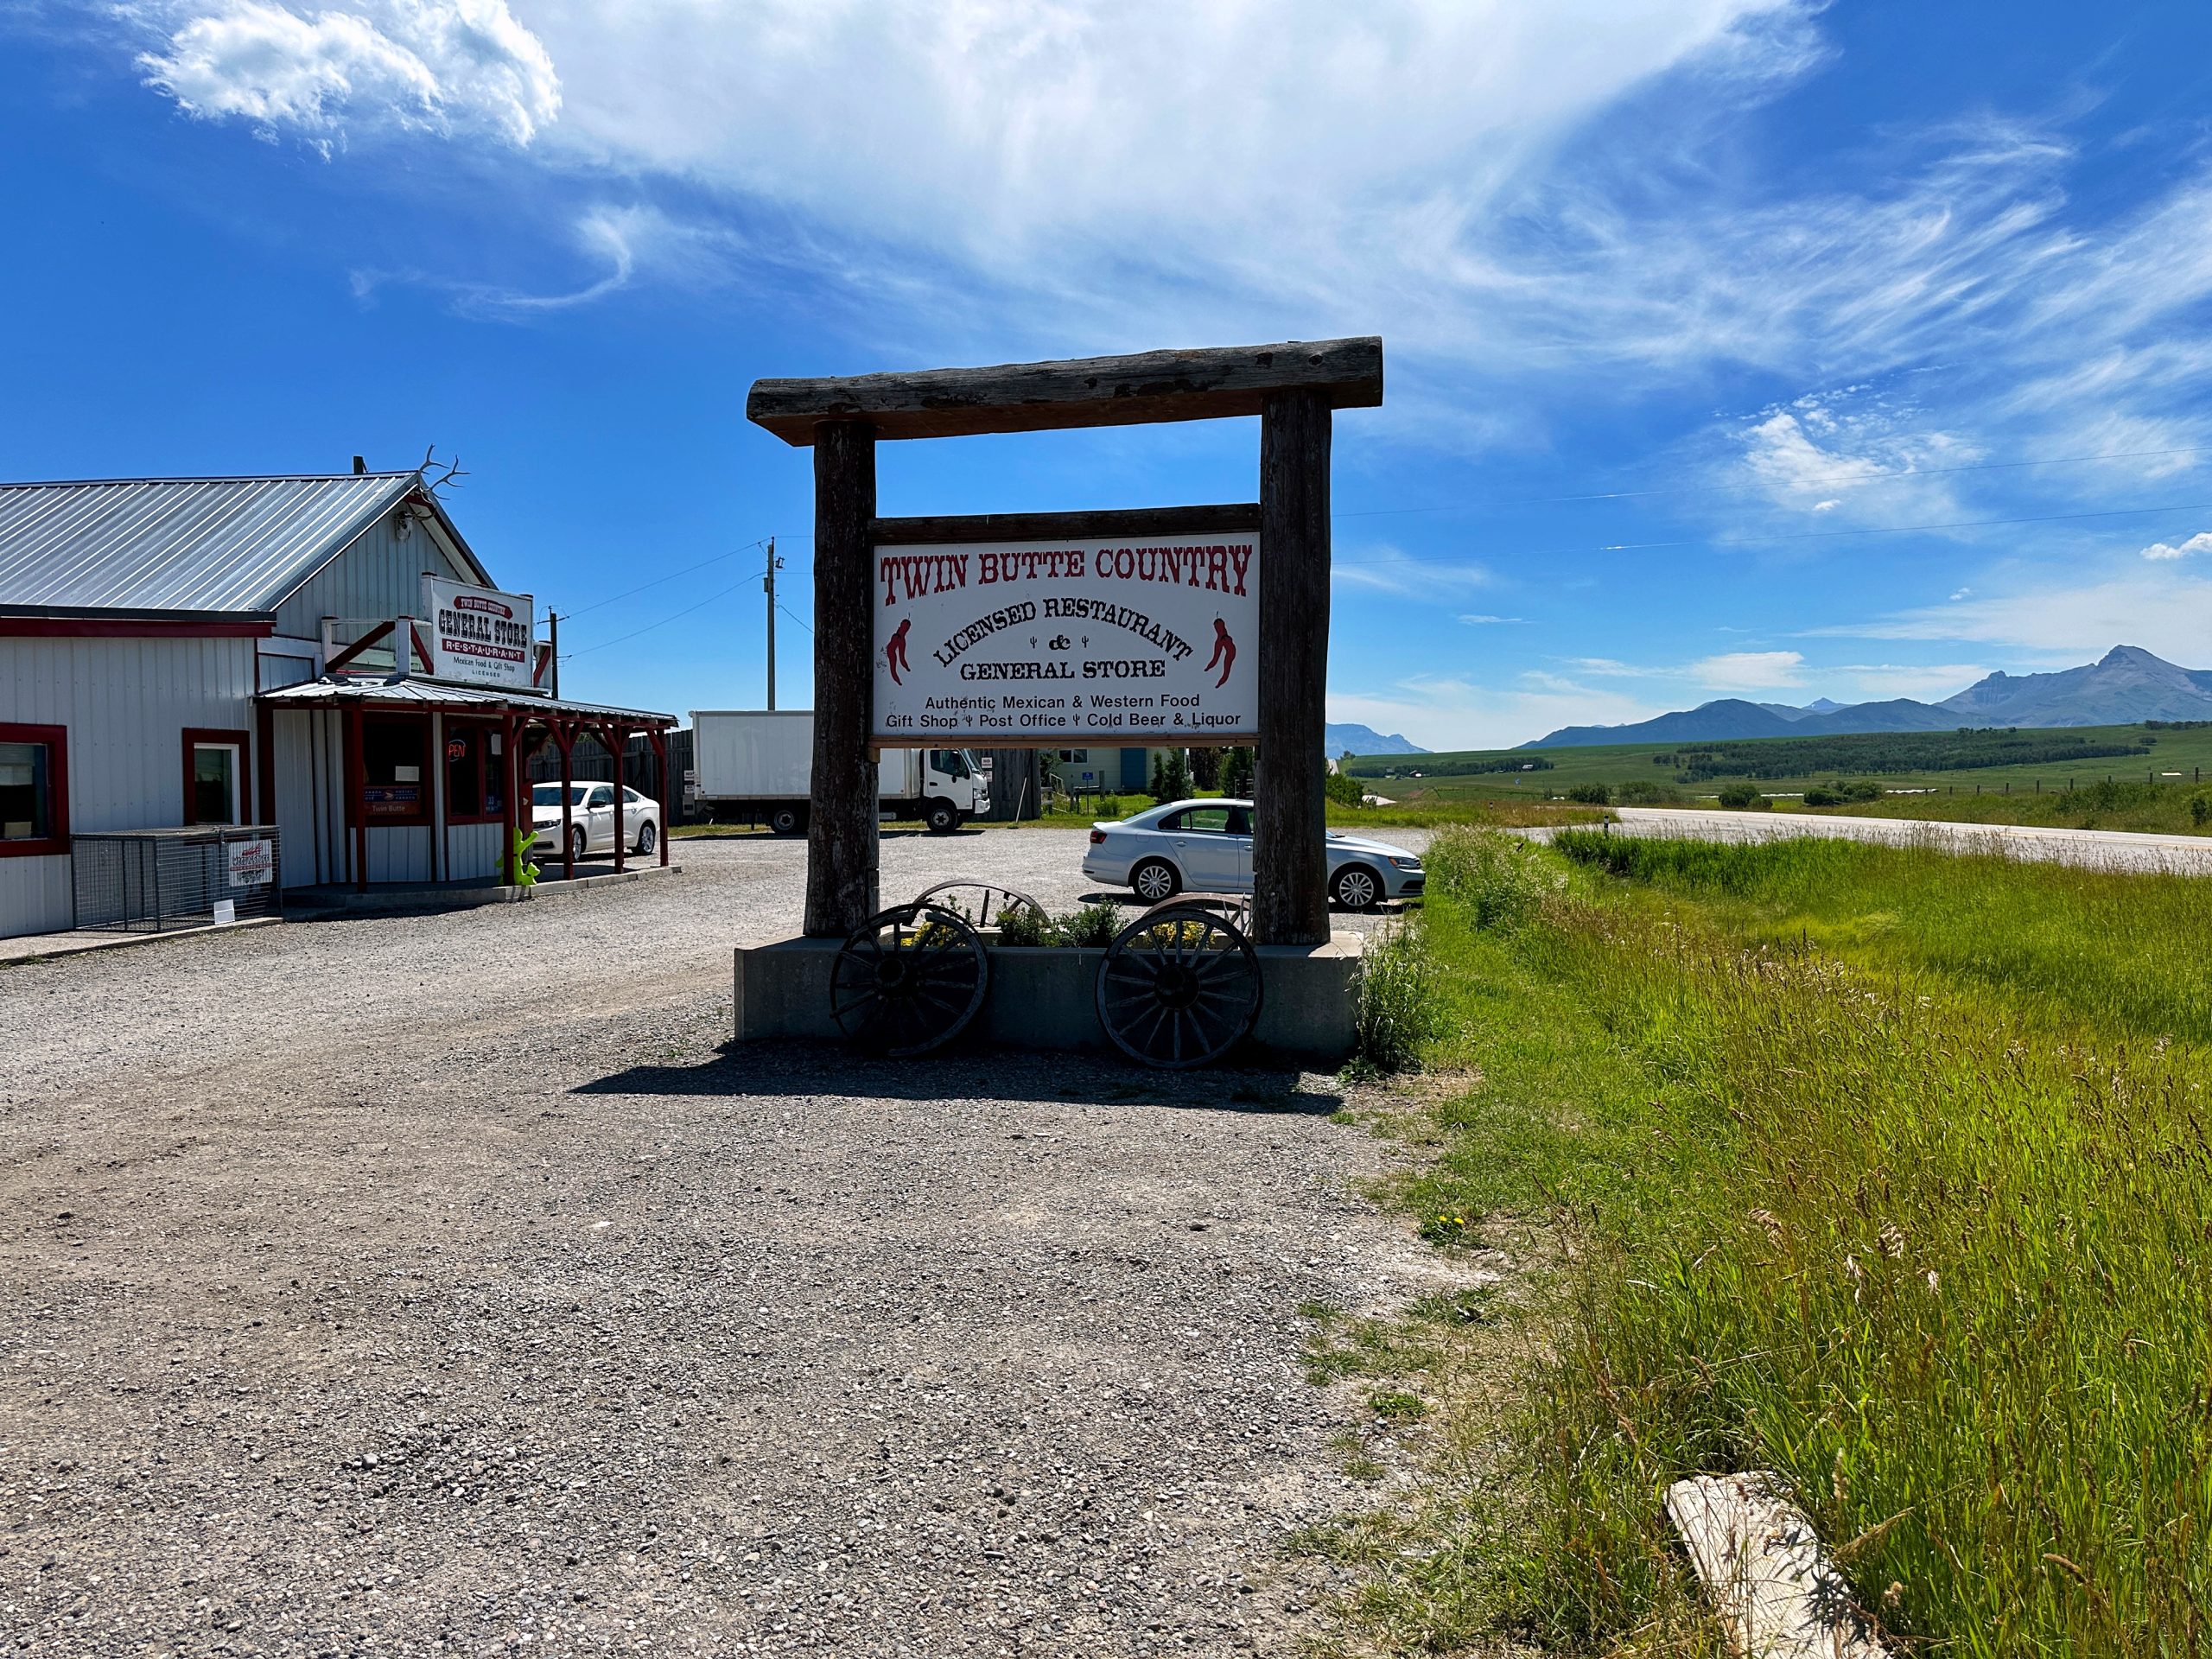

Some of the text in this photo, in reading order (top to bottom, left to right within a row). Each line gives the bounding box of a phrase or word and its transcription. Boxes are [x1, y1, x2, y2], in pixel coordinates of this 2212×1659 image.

[880, 544, 1253, 607] TWIN BUTTE COUNTRY
[438, 608, 528, 648] GENERAL STORE
[932, 597, 1194, 668] LICENSED RESTAURANT
[453, 656, 474, 666] Mexican
[475, 658, 486, 668] Food
[504, 663, 516, 673] Shop
[960, 659, 1166, 681] GENERAL STORE
[925, 694, 1200, 709] Authentic Mexican & Western Food
[887, 712, 1242, 729] Gift Shop Post Office Cold Beer & Liquor
[448, 744, 466, 758] PEN
